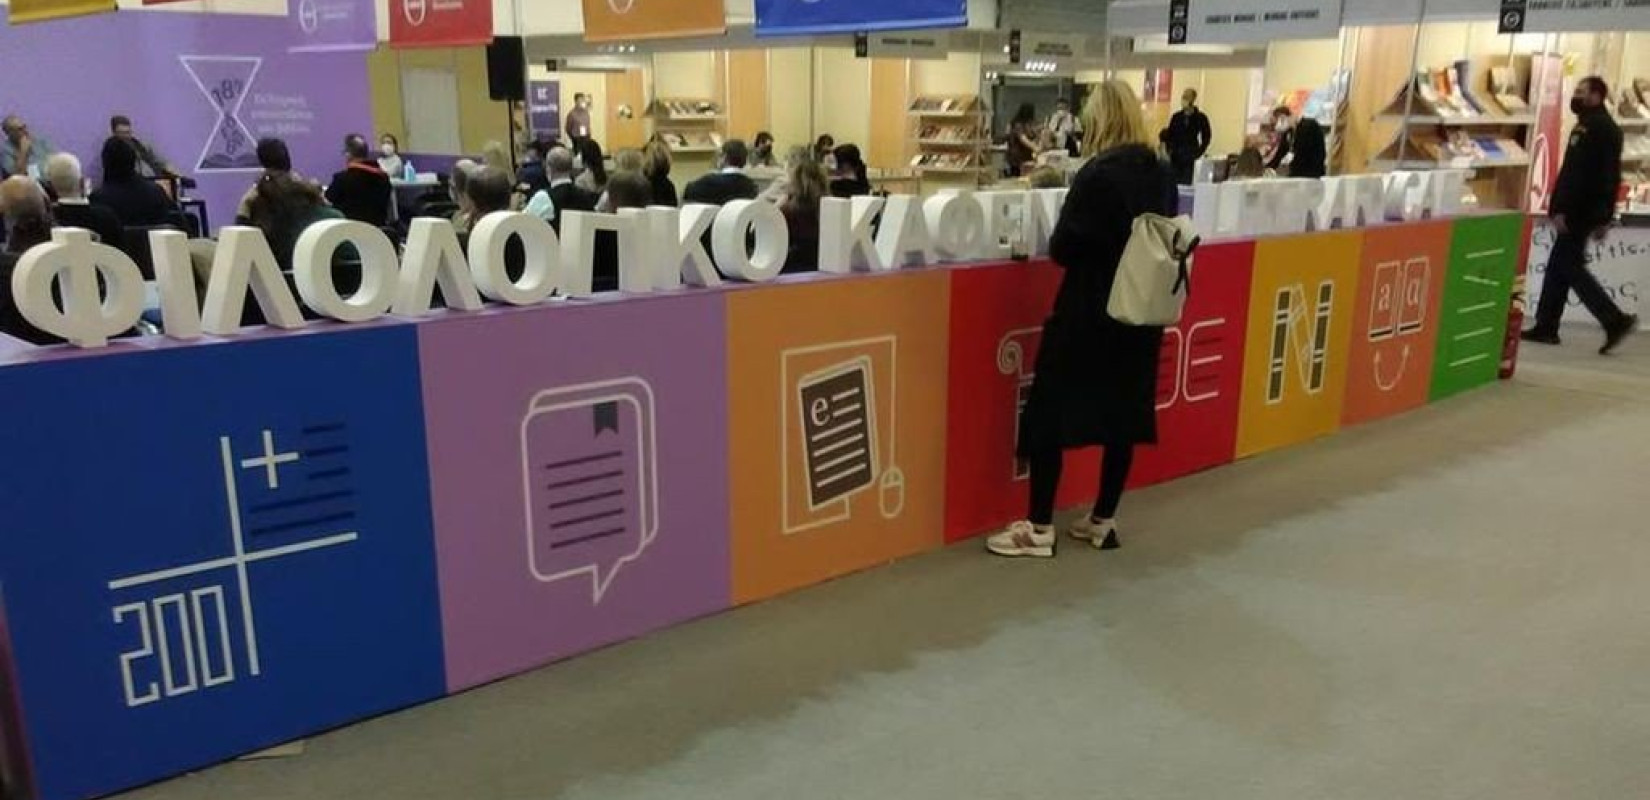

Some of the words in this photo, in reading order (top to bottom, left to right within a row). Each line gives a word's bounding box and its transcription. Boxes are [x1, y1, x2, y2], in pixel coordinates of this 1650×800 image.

[818, 187, 1070, 272] ΚΑΦΕΝ
[811, 397, 830, 427] e
[112, 584, 235, 707] 200
